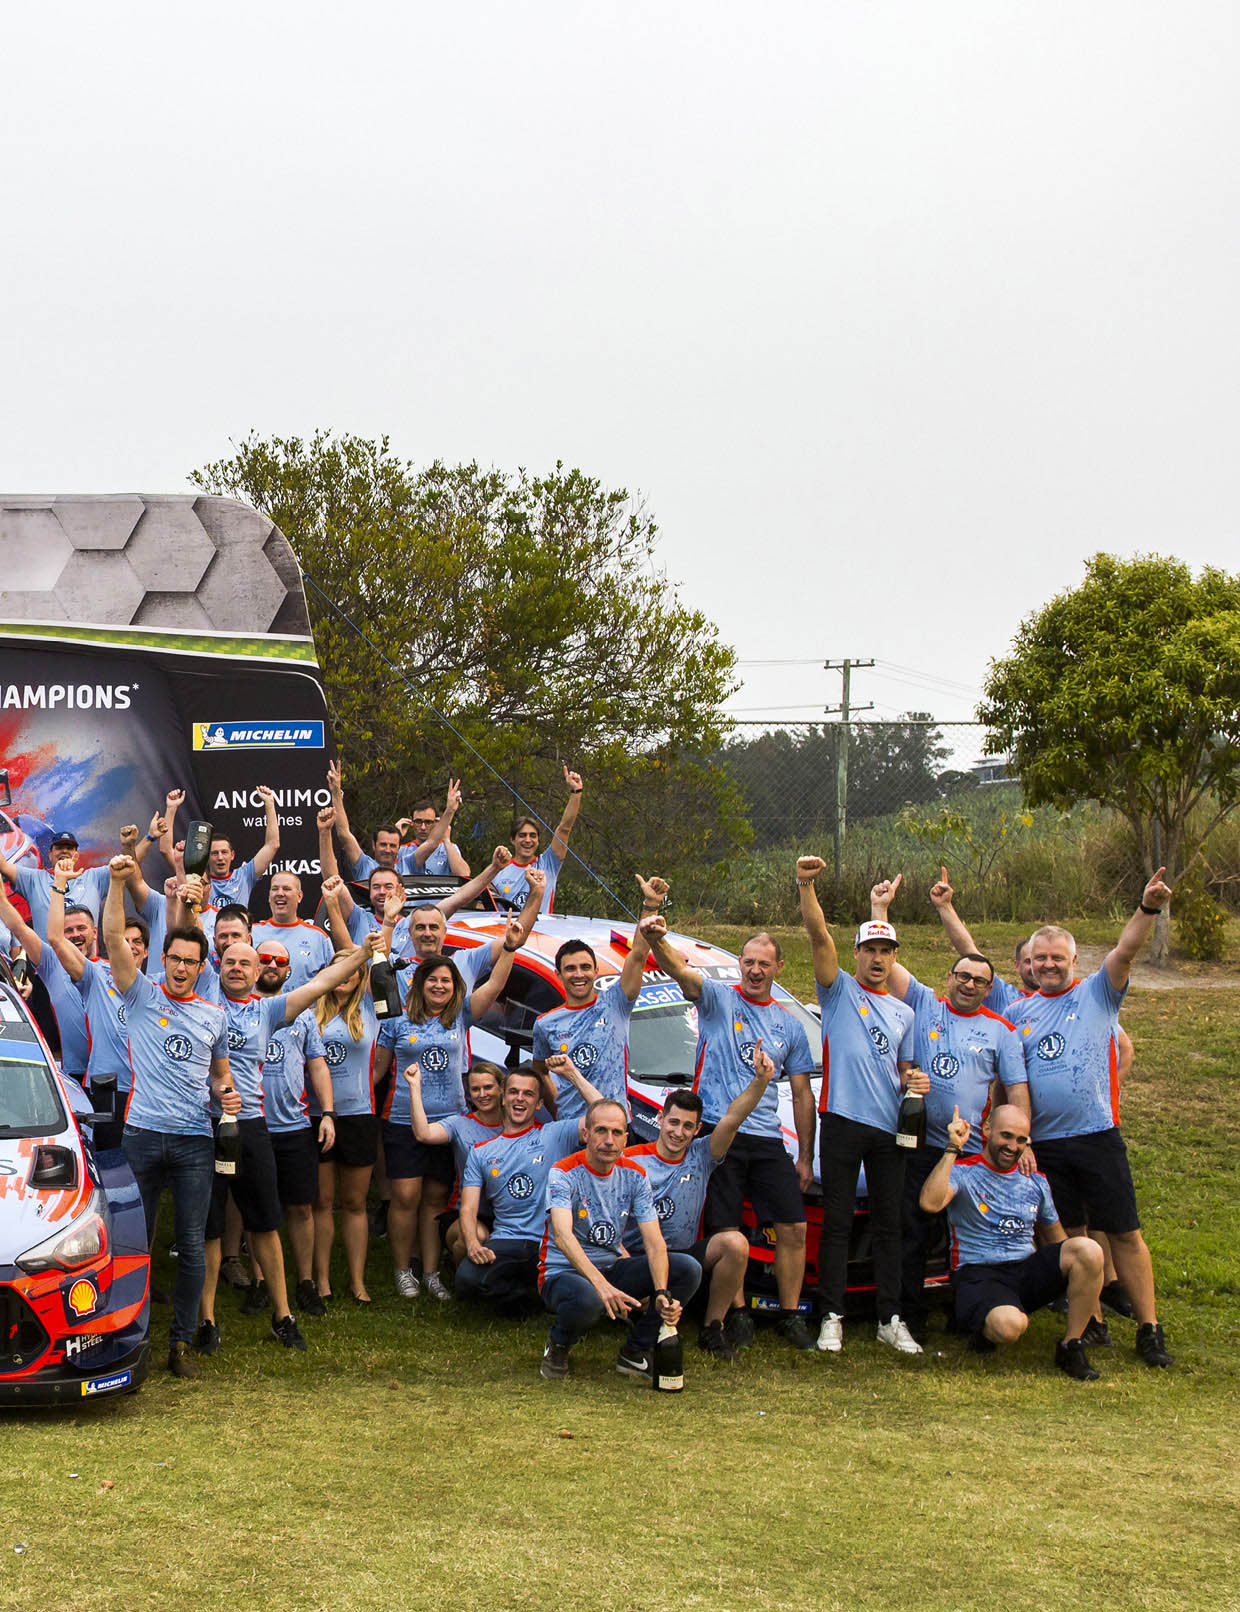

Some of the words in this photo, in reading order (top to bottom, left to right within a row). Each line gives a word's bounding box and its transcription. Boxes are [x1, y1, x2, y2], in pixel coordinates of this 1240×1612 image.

[230, 730, 313, 741] MICHELIN
[213, 788, 332, 810] ANONIMO
[242, 814, 303, 827] wathes
[97, 1375, 128, 1389] MICHELIN
